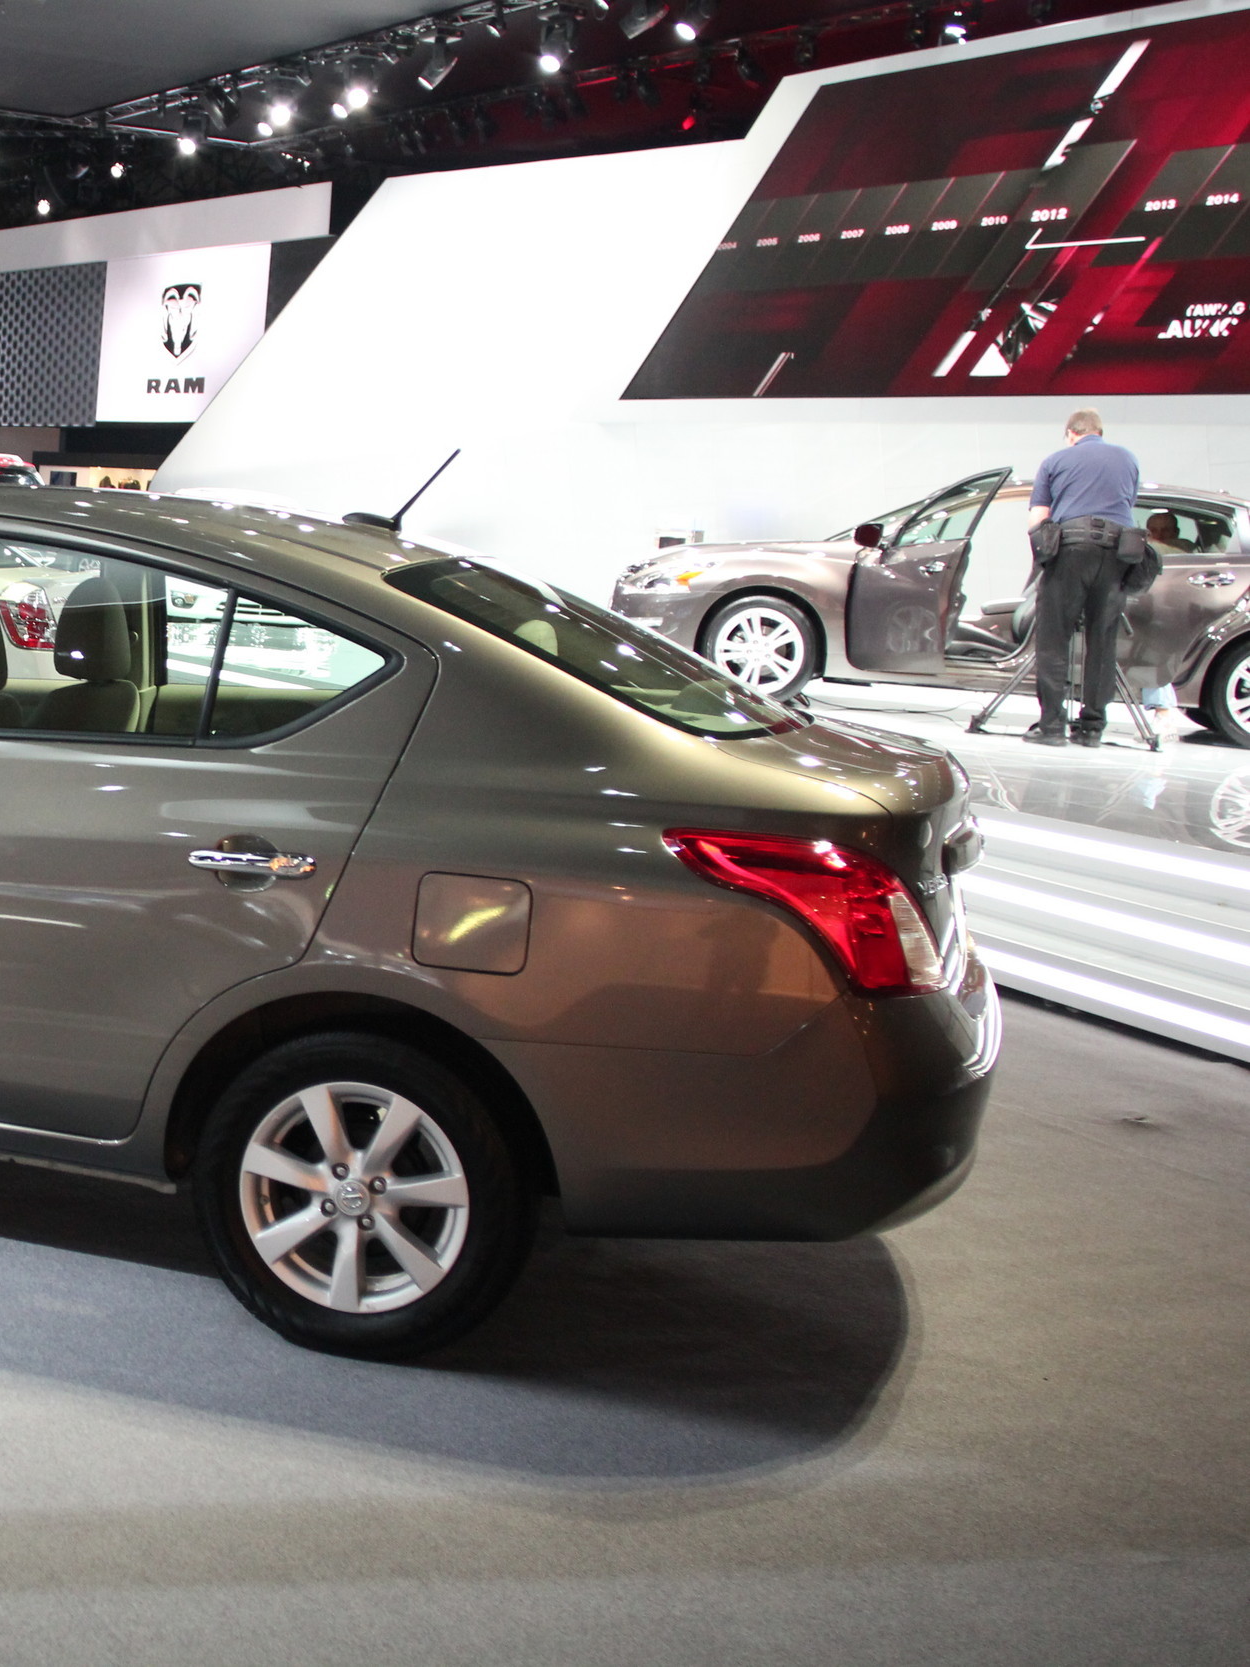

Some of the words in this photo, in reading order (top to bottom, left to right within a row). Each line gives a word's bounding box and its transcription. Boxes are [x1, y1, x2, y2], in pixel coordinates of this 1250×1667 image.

[756, 237, 778, 247] 2005
[798, 233, 821, 243] 2006
[840, 229, 865, 239] 2007
[884, 224, 910, 235] 2008
[931, 220, 957, 231] 2009
[980, 215, 1008, 226] 2010
[1030, 207, 1067, 222] 2012
[1144, 198, 1176, 212] 2013
[1205, 192, 1239, 206] 2014
[147, 377, 205, 394] RAM
